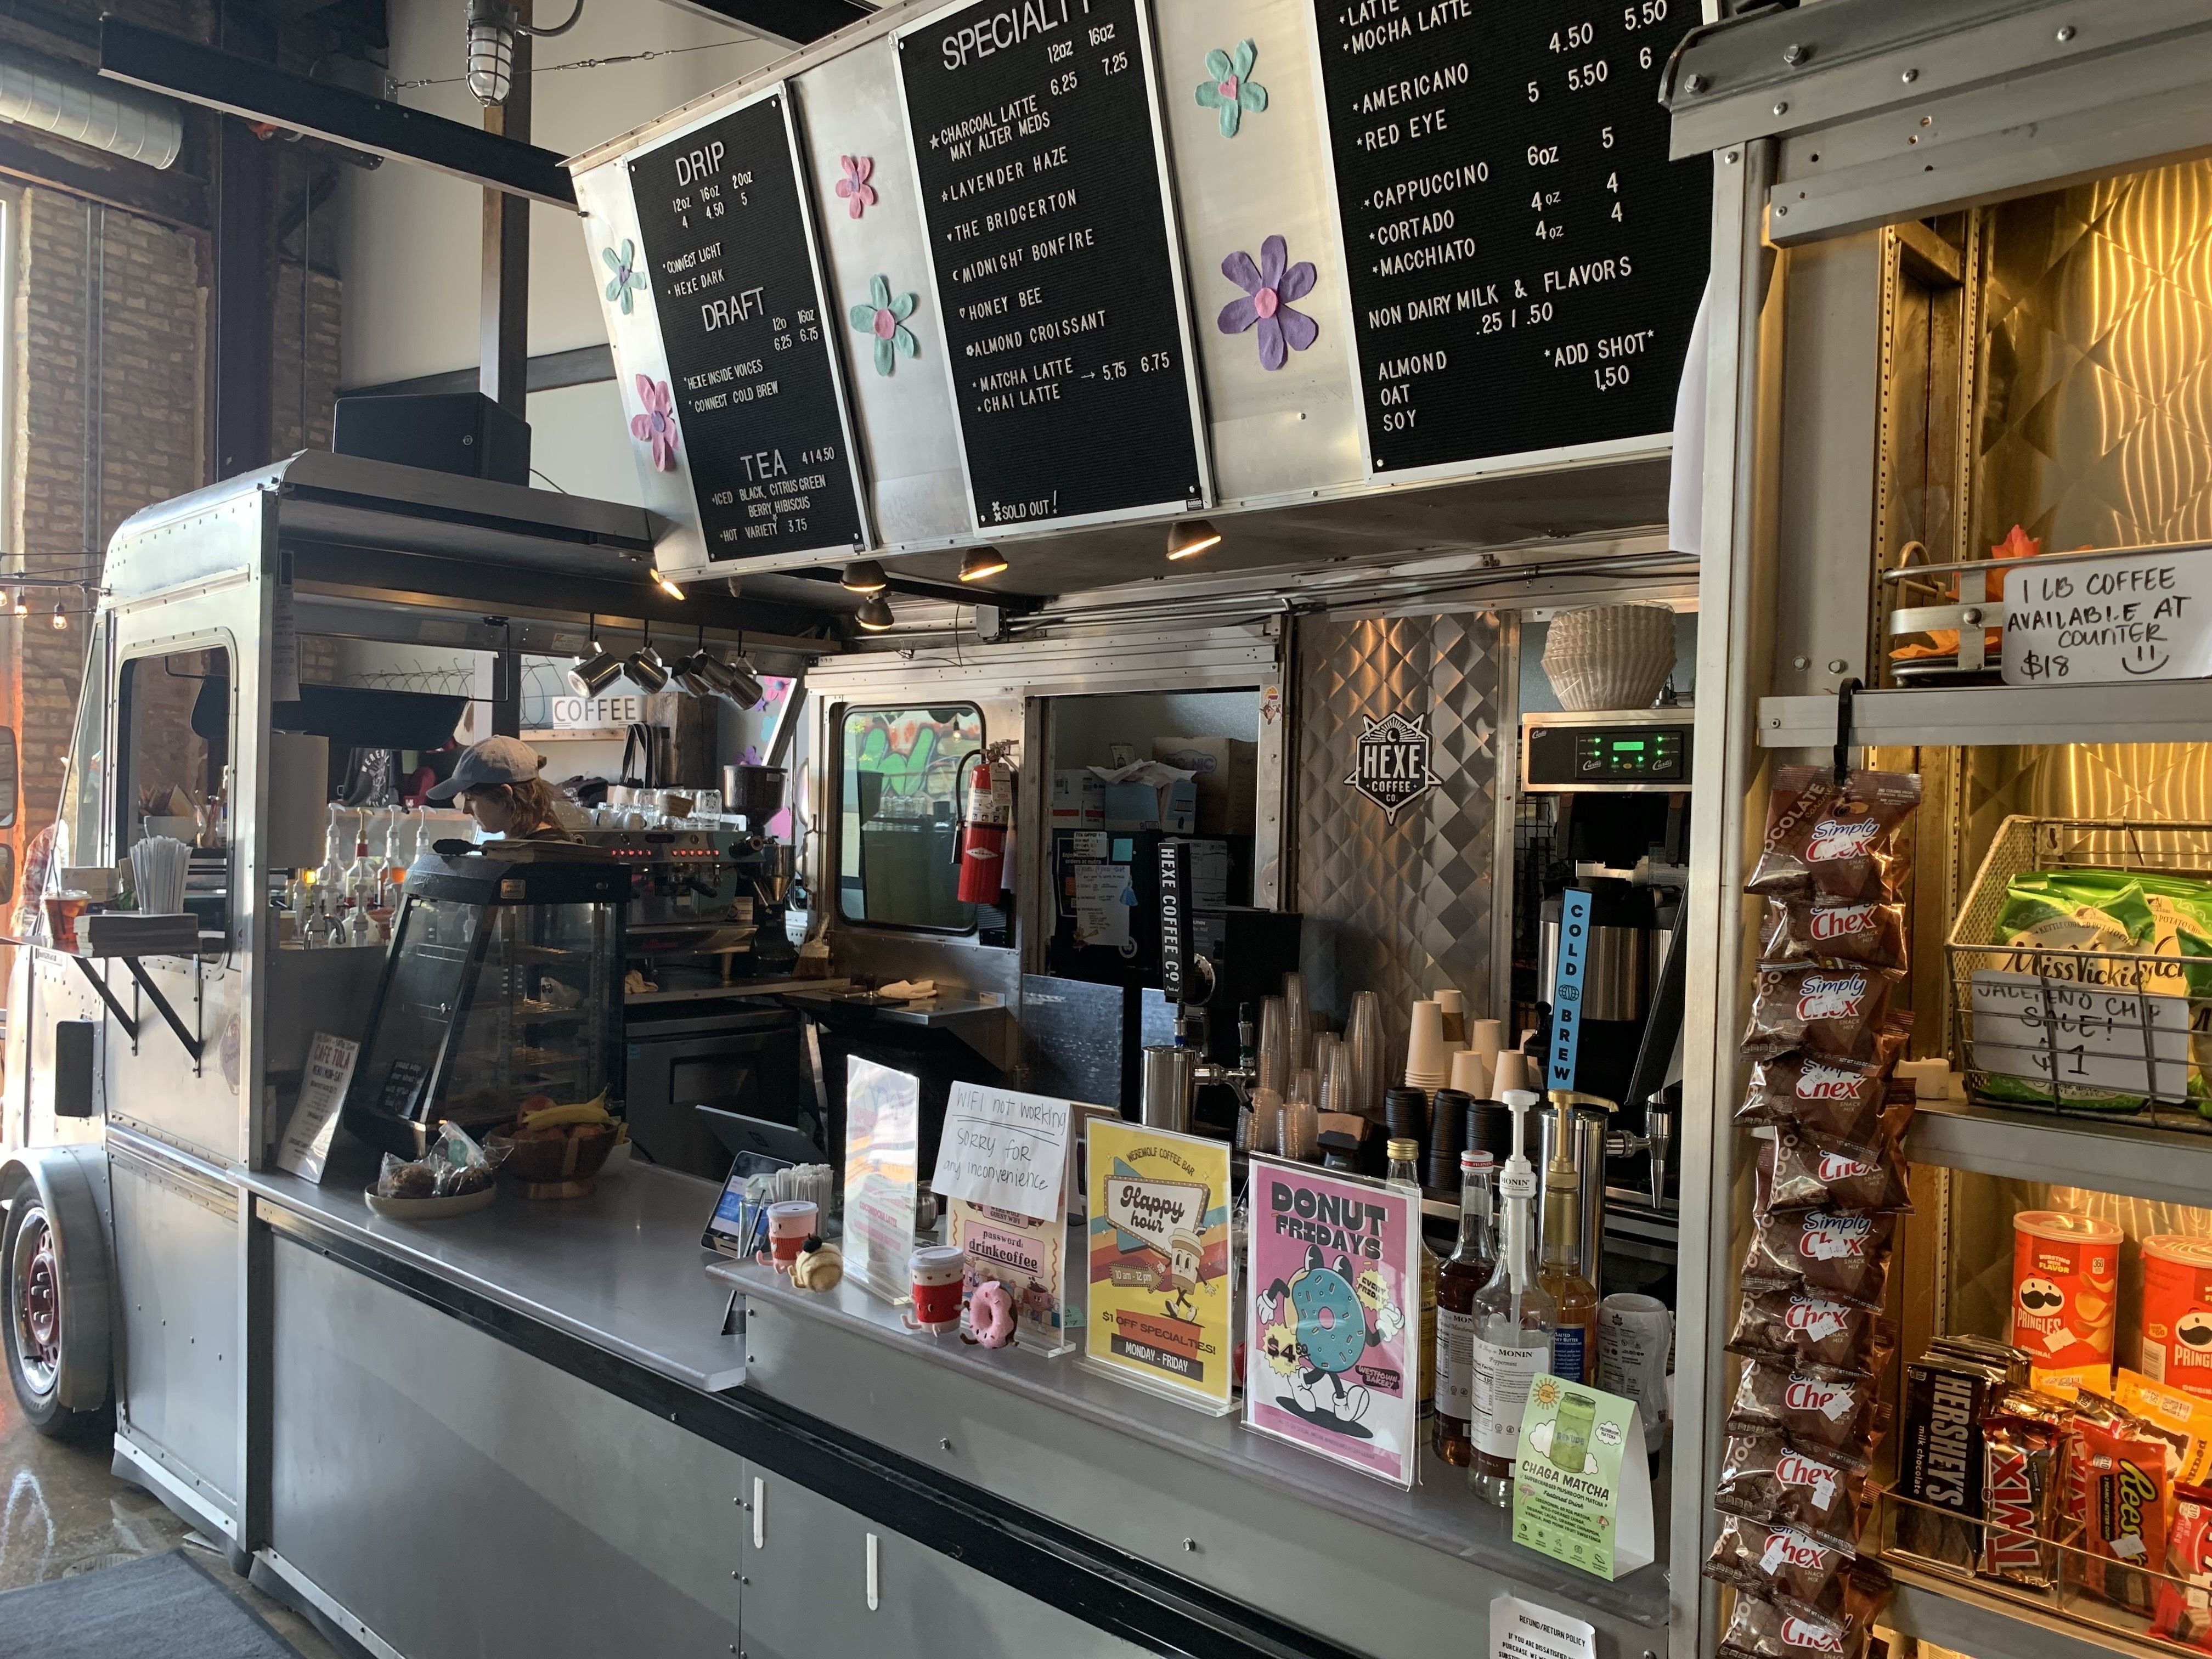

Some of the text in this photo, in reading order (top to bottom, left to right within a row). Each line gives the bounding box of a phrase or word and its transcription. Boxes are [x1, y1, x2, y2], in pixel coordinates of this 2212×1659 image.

[1352, 0, 1667, 55] MOCHA LATTE 4.50 5.50
[1050, 51, 1128, 96] 6.25 7.25
[1363, 47, 1652, 115] AMERICANO 5 5.50 6
[941, 94, 1037, 145] CHARCOAL LATTE
[1365, 109, 1447, 151] RED EYE
[950, 112, 1050, 162] MAY ALTER MEDS
[1602, 126, 1614, 149] 5
[675, 141, 724, 187] DRIP
[950, 146, 1068, 201] LAVENDER HAZE
[1373, 162, 1488, 210] CAPPUCCINO
[1606, 172, 1618, 194] 4
[706, 201, 724, 219] 4.50
[954, 188, 1076, 241] THE BRIDGERTON
[1378, 210, 1454, 246] CORTADO
[1380, 201, 1623, 277] MACCHIATO 4
[667, 242, 721, 274] CONNECT LIGHT
[962, 249, 1023, 284] MIDNIGHT
[674, 270, 725, 297] HEXE DARK
[1369, 256, 1632, 329] NON DAIRY MILK & FLAVORS
[701, 286, 764, 332] DRAFT
[968, 287, 1042, 321] HONEY BEE
[1476, 302, 1553, 335] .25 .50
[774, 326, 819, 352] 6.25 6.75
[975, 309, 1105, 357] ALMOND CROISSANT
[1555, 331, 1646, 368] ADD SHOT
[687, 358, 763, 390] HEXE INSIDE VOICES
[980, 351, 1170, 392] MATCHA LATTE 5.75 6.75
[1379, 351, 1447, 381] ALMOND
[695, 380, 778, 413] CONNECT COLD BREW
[984, 383, 1060, 413] CHAI LATTE
[1380, 383, 1410, 407] OAT
[1383, 409, 1416, 432] SOY
[740, 449, 788, 481] TEA
[714, 488, 733, 506] ICED
[769, 479, 798, 496] CITRUS
[799, 474, 826, 491] GREEN
[748, 495, 810, 518] BERRY HIBISCUS
[1002, 503, 1026, 520] SOLD
[723, 518, 808, 542] HOT VARIETY 3.75
[2042, 567, 2176, 601] LB COFFEE
[2007, 596, 2191, 632] AVAILABLE AT
[2021, 650, 2069, 679] $18
[554, 698, 636, 721] COFFEE
[1364, 745, 1420, 778] HEXE
[1372, 781, 1410, 792] COFFEE
[1814, 819, 1879, 839] Simply
[1161, 848, 1178, 954] HEXE COFFEE
[1813, 910, 1876, 938] Chex
[1565, 904, 1583, 977] COLD
[1803, 975, 1866, 994] Simply
[1554, 1009, 1573, 1081] BREW
[957, 1087, 984, 1113] WIFI
[992, 1097, 1015, 1118] not
[957, 1128, 996, 1158] SORRY
[944, 1160, 1048, 1190] any inconvenience
[1126, 1147, 1195, 1176] WEREWOLF COFFEE BAR
[990, 1211, 1021, 1224] GUEST WIFI
[1120, 1185, 1185, 1224] Happy
[1272, 1181, 1388, 1237] DONUT
[1131, 1210, 1164, 1233] hour
[1804, 1212, 1870, 1234] Simply
[968, 1238, 1038, 1268] drinkcoffee
[983, 1231, 1023, 1247] password:
[1276, 1214, 1383, 1261] FRIDAYS
[1115, 1269, 1152, 1283] 10 am 12 pm
[2039, 1263, 2069, 1273] FLAVOR
[1358, 1283, 1386, 1304] FRIDAY
[1362, 1277, 1386, 1295] EVERY
[1787, 1305, 1848, 1329] Chex
[2017, 1307, 2061, 1336] PRINGLES
[1103, 1311, 1216, 1355] $1 OFF SPECIALTIES!
[1126, 1340, 1188, 1373] MONDAY FRIDAY
[1499, 1349, 1532, 1357] MONIN
[1367, 1374, 1393, 1388] BAKERY
[1600, 1426, 1619, 1436] MUSHROOM
[1600, 1431, 1616, 1440] MATCHA
[1926, 1374, 1972, 1506] HERSHEY'S
[1522, 1460, 1610, 1500] CHAGA MATCHA
[1778, 1458, 1839, 1483] Chex
[1914, 1448, 1923, 1494] chocolate
[1557, 1486, 1603, 1507] MUSHROOM MATCHA
[1987, 1453, 2039, 1575] TWIX
[1515, 1635, 1524, 1644] YOU
[1566, 1633, 1585, 1647] POLICY
